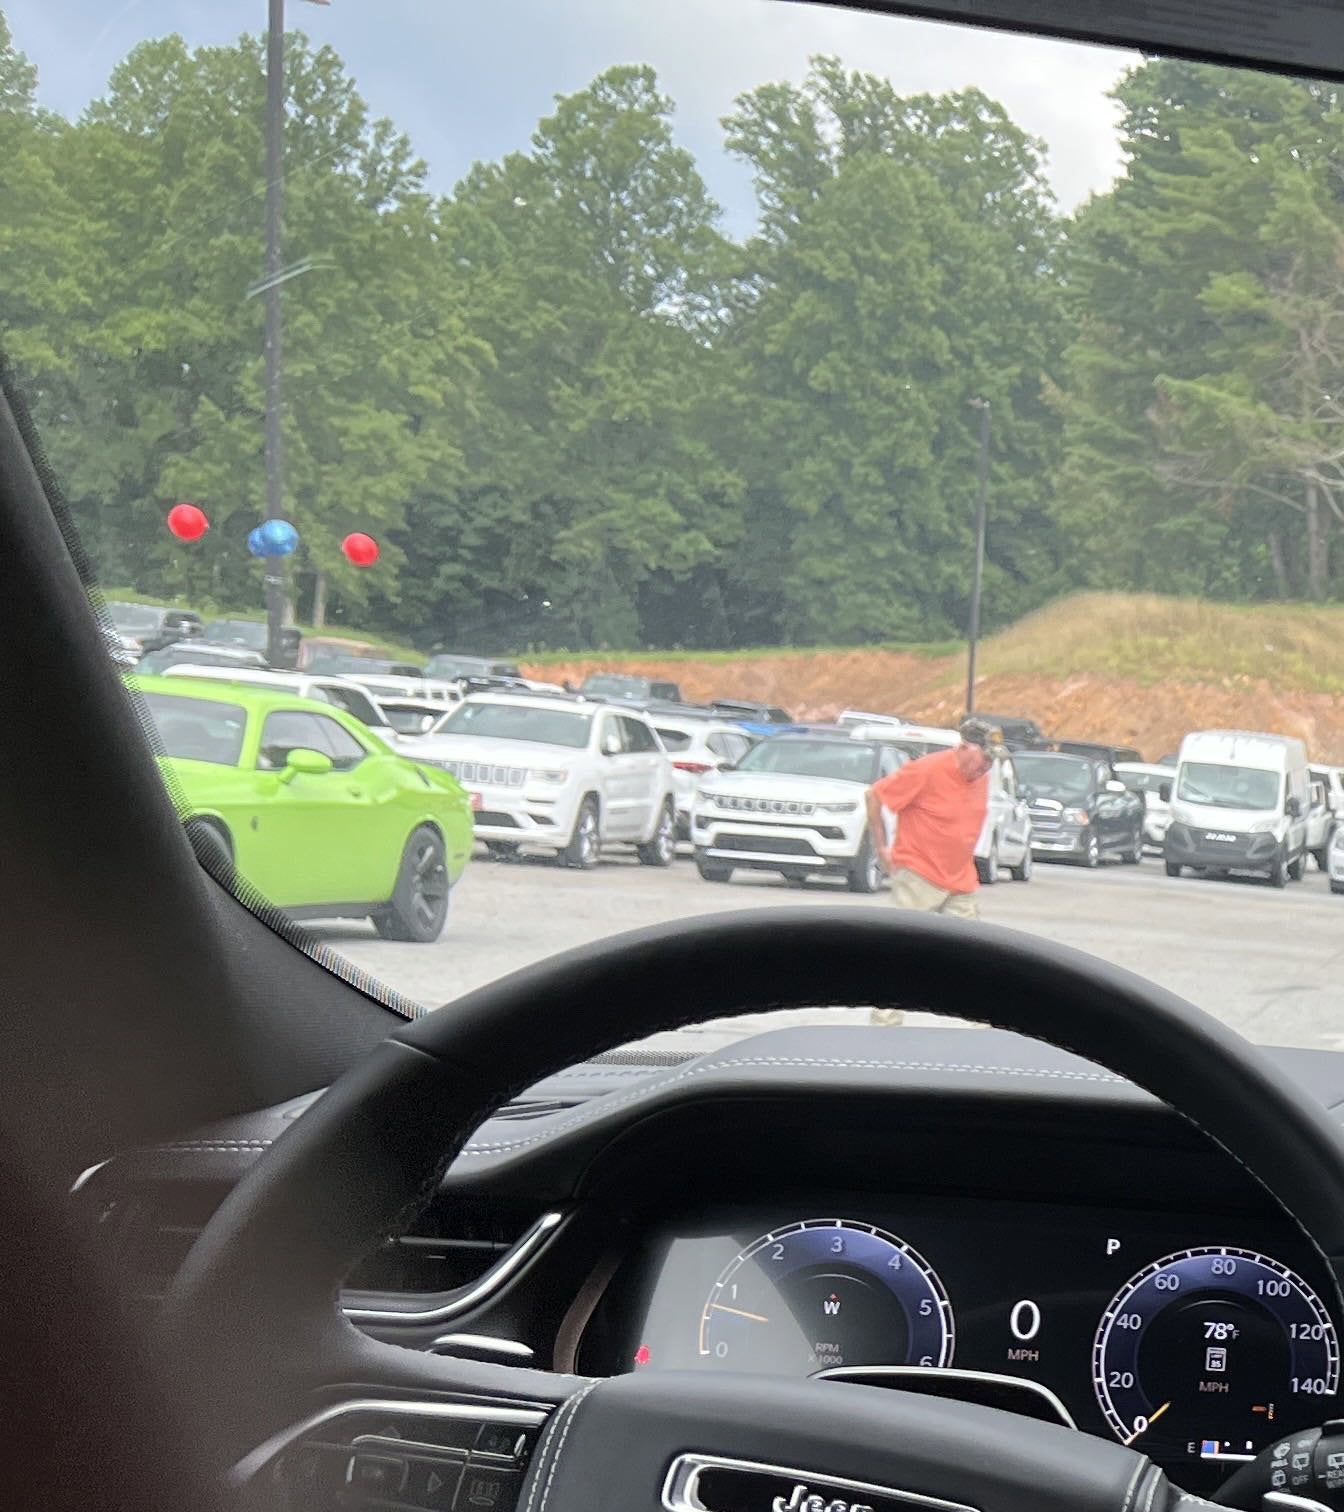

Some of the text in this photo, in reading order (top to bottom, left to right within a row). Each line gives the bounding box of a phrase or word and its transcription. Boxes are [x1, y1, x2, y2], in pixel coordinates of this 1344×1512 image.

[772, 1243, 784, 1260] 2
[831, 1236, 843, 1252] 3
[1106, 1238, 1121, 1255] P
[888, 1254, 901, 1270] 4
[1210, 1259, 1236, 1276] 80
[731, 1284, 737, 1299] 1
[1154, 1275, 1179, 1291] 60
[1256, 1279, 1291, 1297] 100
[824, 1300, 840, 1315] W
[919, 1299, 932, 1315] 5
[1009, 1299, 1041, 1340] 0
[1116, 1313, 1142, 1330] 40
[1289, 1323, 1323, 1340] 120
[716, 1341, 728, 1358] 0
[815, 1343, 840, 1353] RPM
[1007, 1348, 1039, 1361] MPH
[1110, 1371, 1134, 1388] 20
[1199, 1381, 1229, 1393] MPH
[1291, 1377, 1325, 1395] 140
[1133, 1415, 1148, 1432] 0
[1187, 1442, 1195, 1453] E
